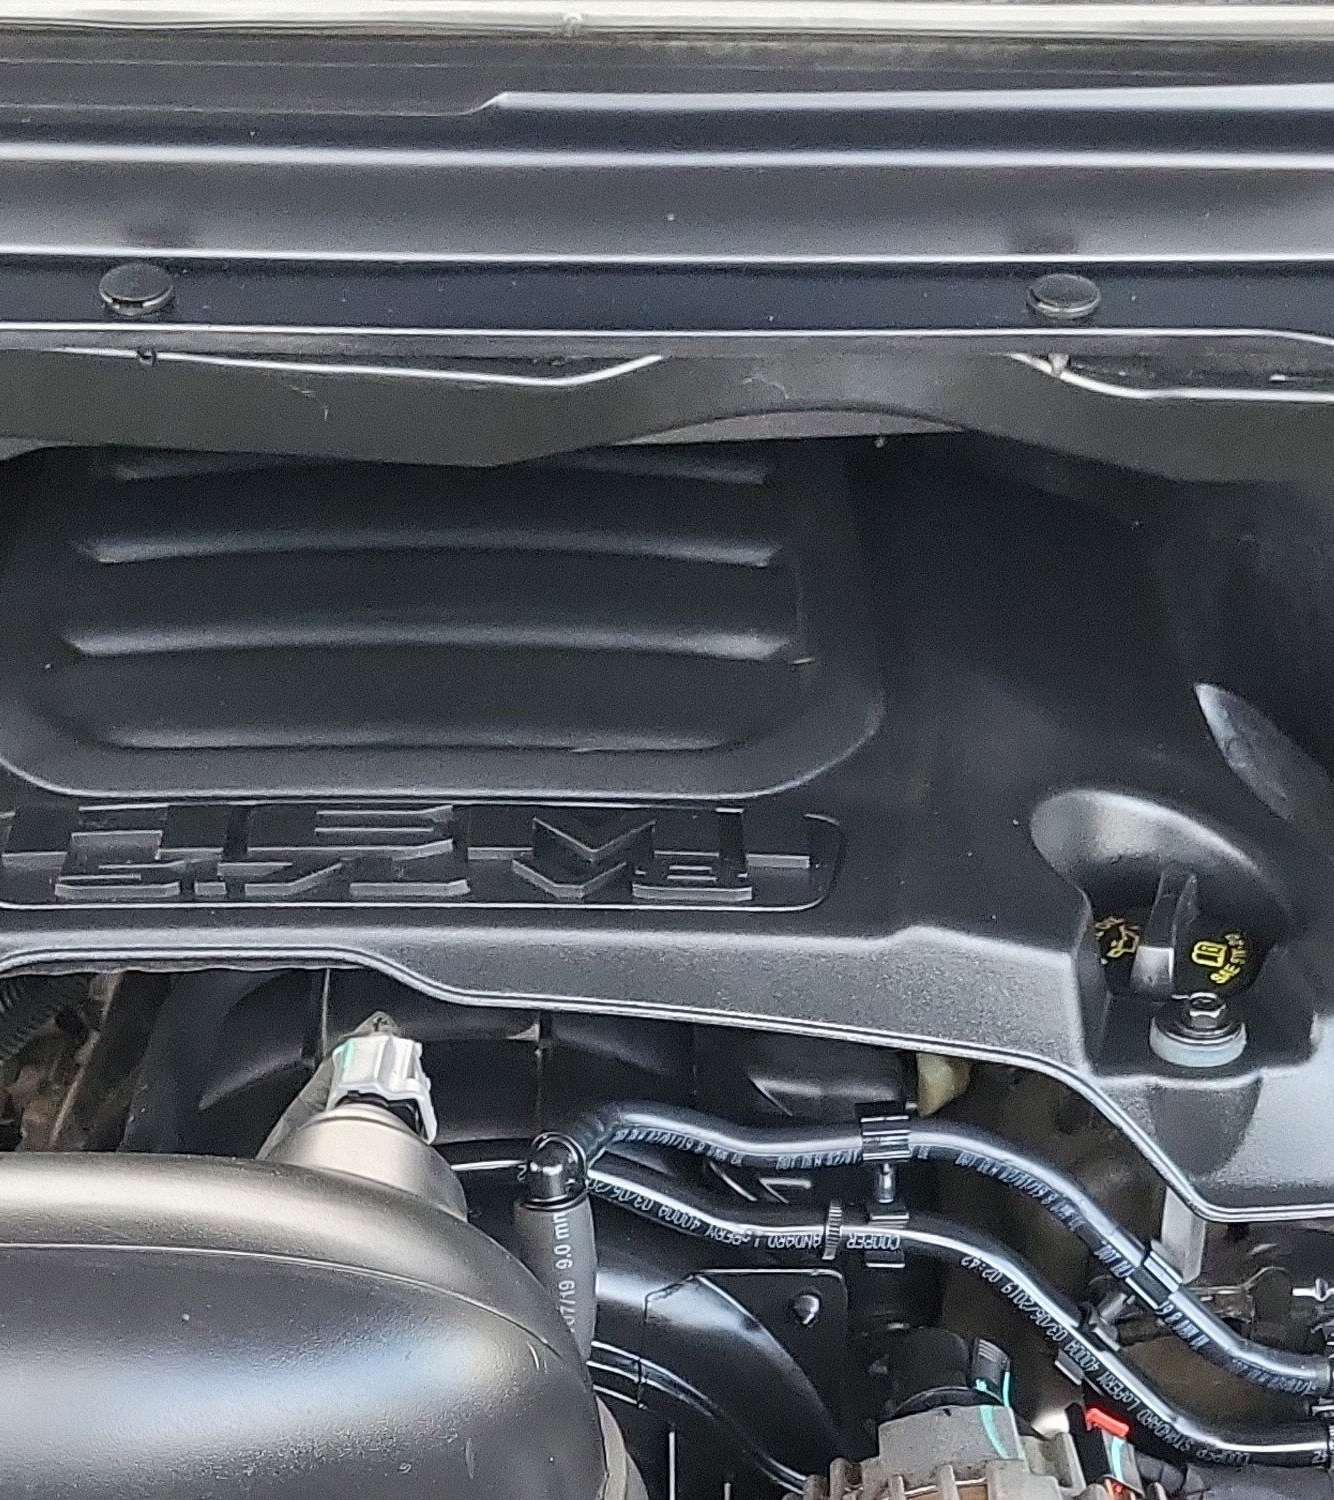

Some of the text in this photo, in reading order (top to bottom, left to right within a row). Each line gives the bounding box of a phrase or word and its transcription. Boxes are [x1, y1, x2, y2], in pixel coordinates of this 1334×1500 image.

[589, 1177, 653, 1212] 03/06/20
[768, 1234, 824, 1250] ANDARD
[553, 1244, 573, 1269] 9.0
